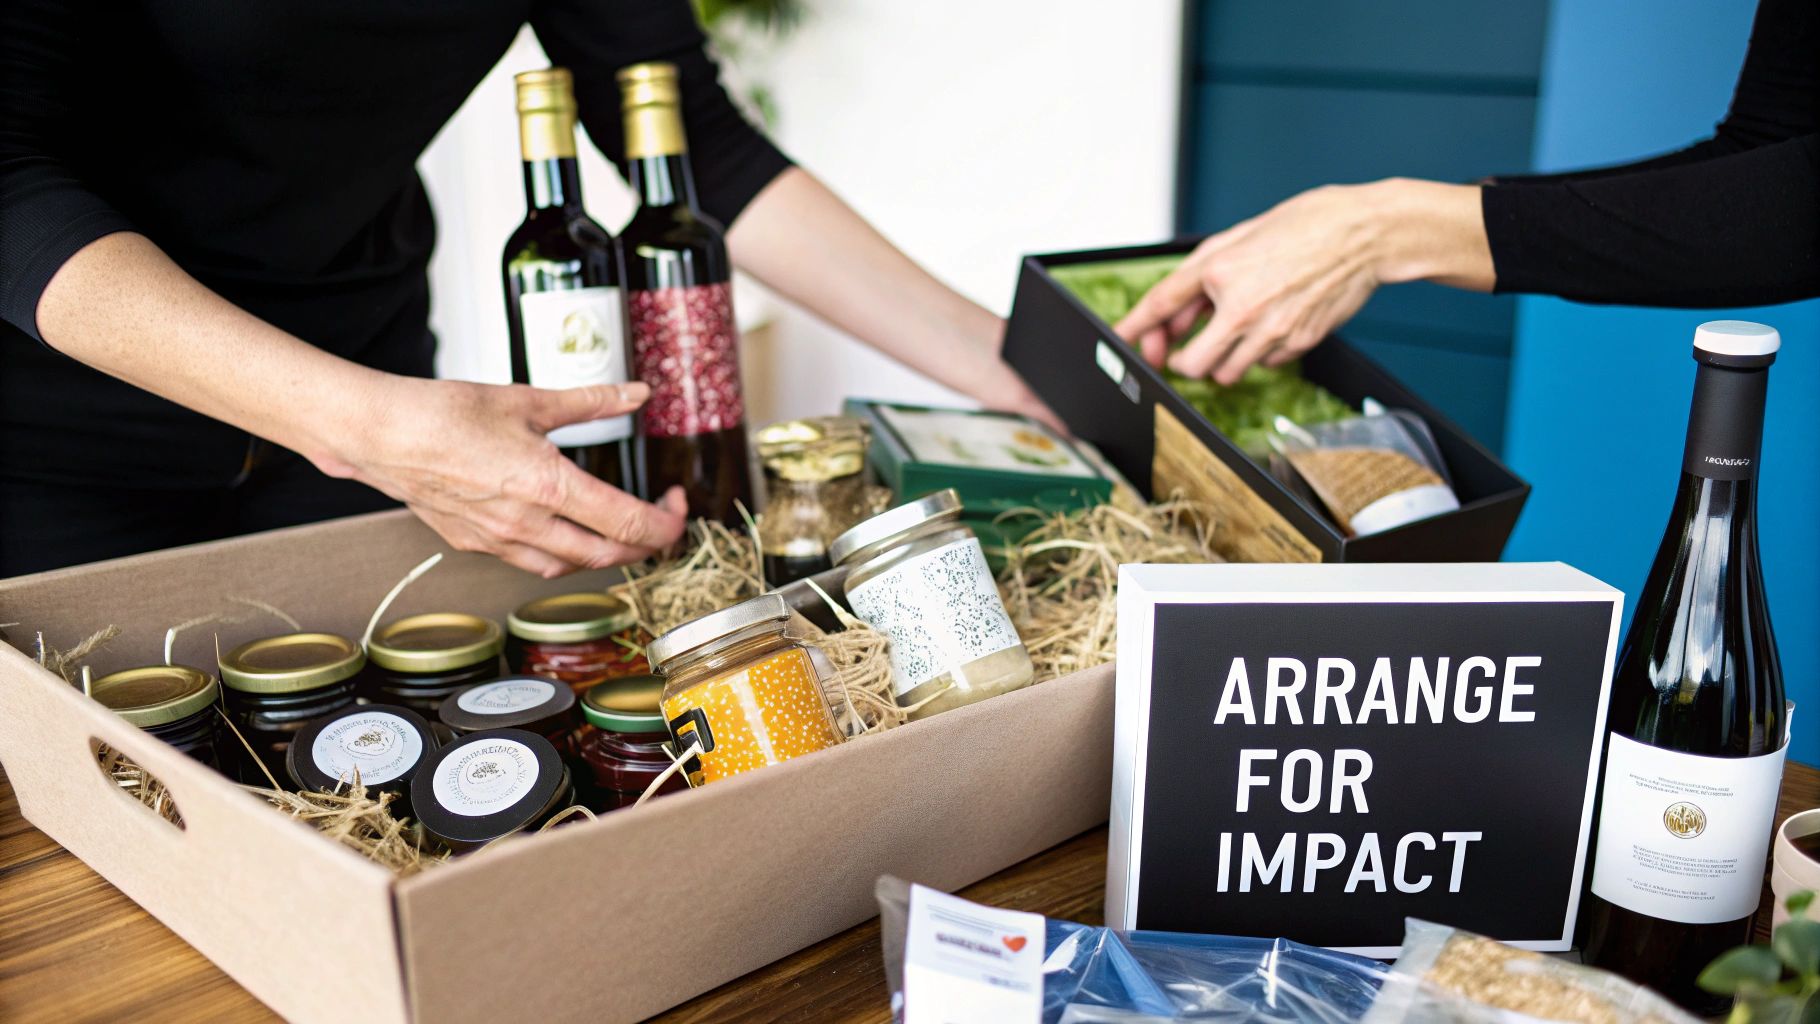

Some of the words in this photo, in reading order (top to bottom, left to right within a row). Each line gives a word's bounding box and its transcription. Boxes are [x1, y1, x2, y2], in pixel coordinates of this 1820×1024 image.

[1213, 656, 1542, 724] ARRANGE
[1236, 748, 1373, 813] FOR
[1216, 831, 1482, 893] IMPACT
